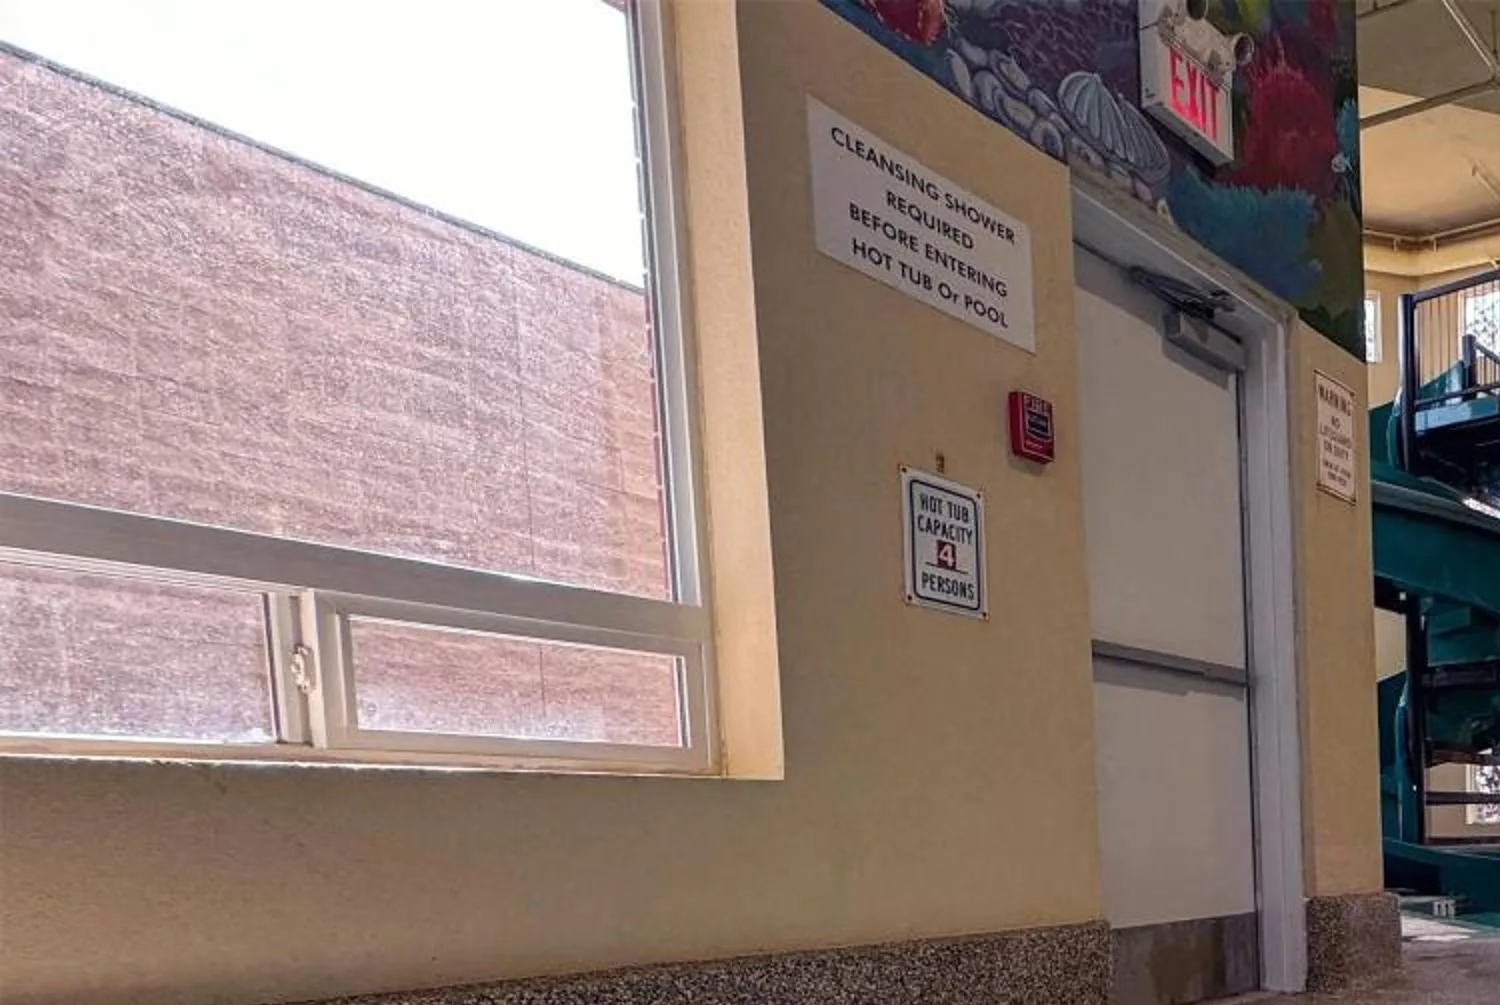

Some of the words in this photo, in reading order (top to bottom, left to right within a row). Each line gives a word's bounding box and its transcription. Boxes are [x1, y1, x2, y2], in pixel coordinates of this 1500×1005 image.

[1170, 46, 1219, 140] EXIT
[831, 126, 939, 201] CLEANSING
[945, 193, 1016, 245] SHOWER
[886, 190, 974, 249] REQUIRED
[849, 203, 919, 253] BEFORE
[925, 244, 1008, 298] ENTERING
[852, 238, 891, 271] HOT
[899, 260, 932, 291] TUB
[938, 282, 960, 304] Or
[964, 295, 1009, 329] POOL
[1319, 384, 1351, 417] WARNING
[917, 514, 973, 545] CAPACITY
[920, 494, 943, 516] HOT
[948, 502, 969, 523] TUB
[939, 545, 954, 567] 4
[922, 571, 974, 600] PERSONS
